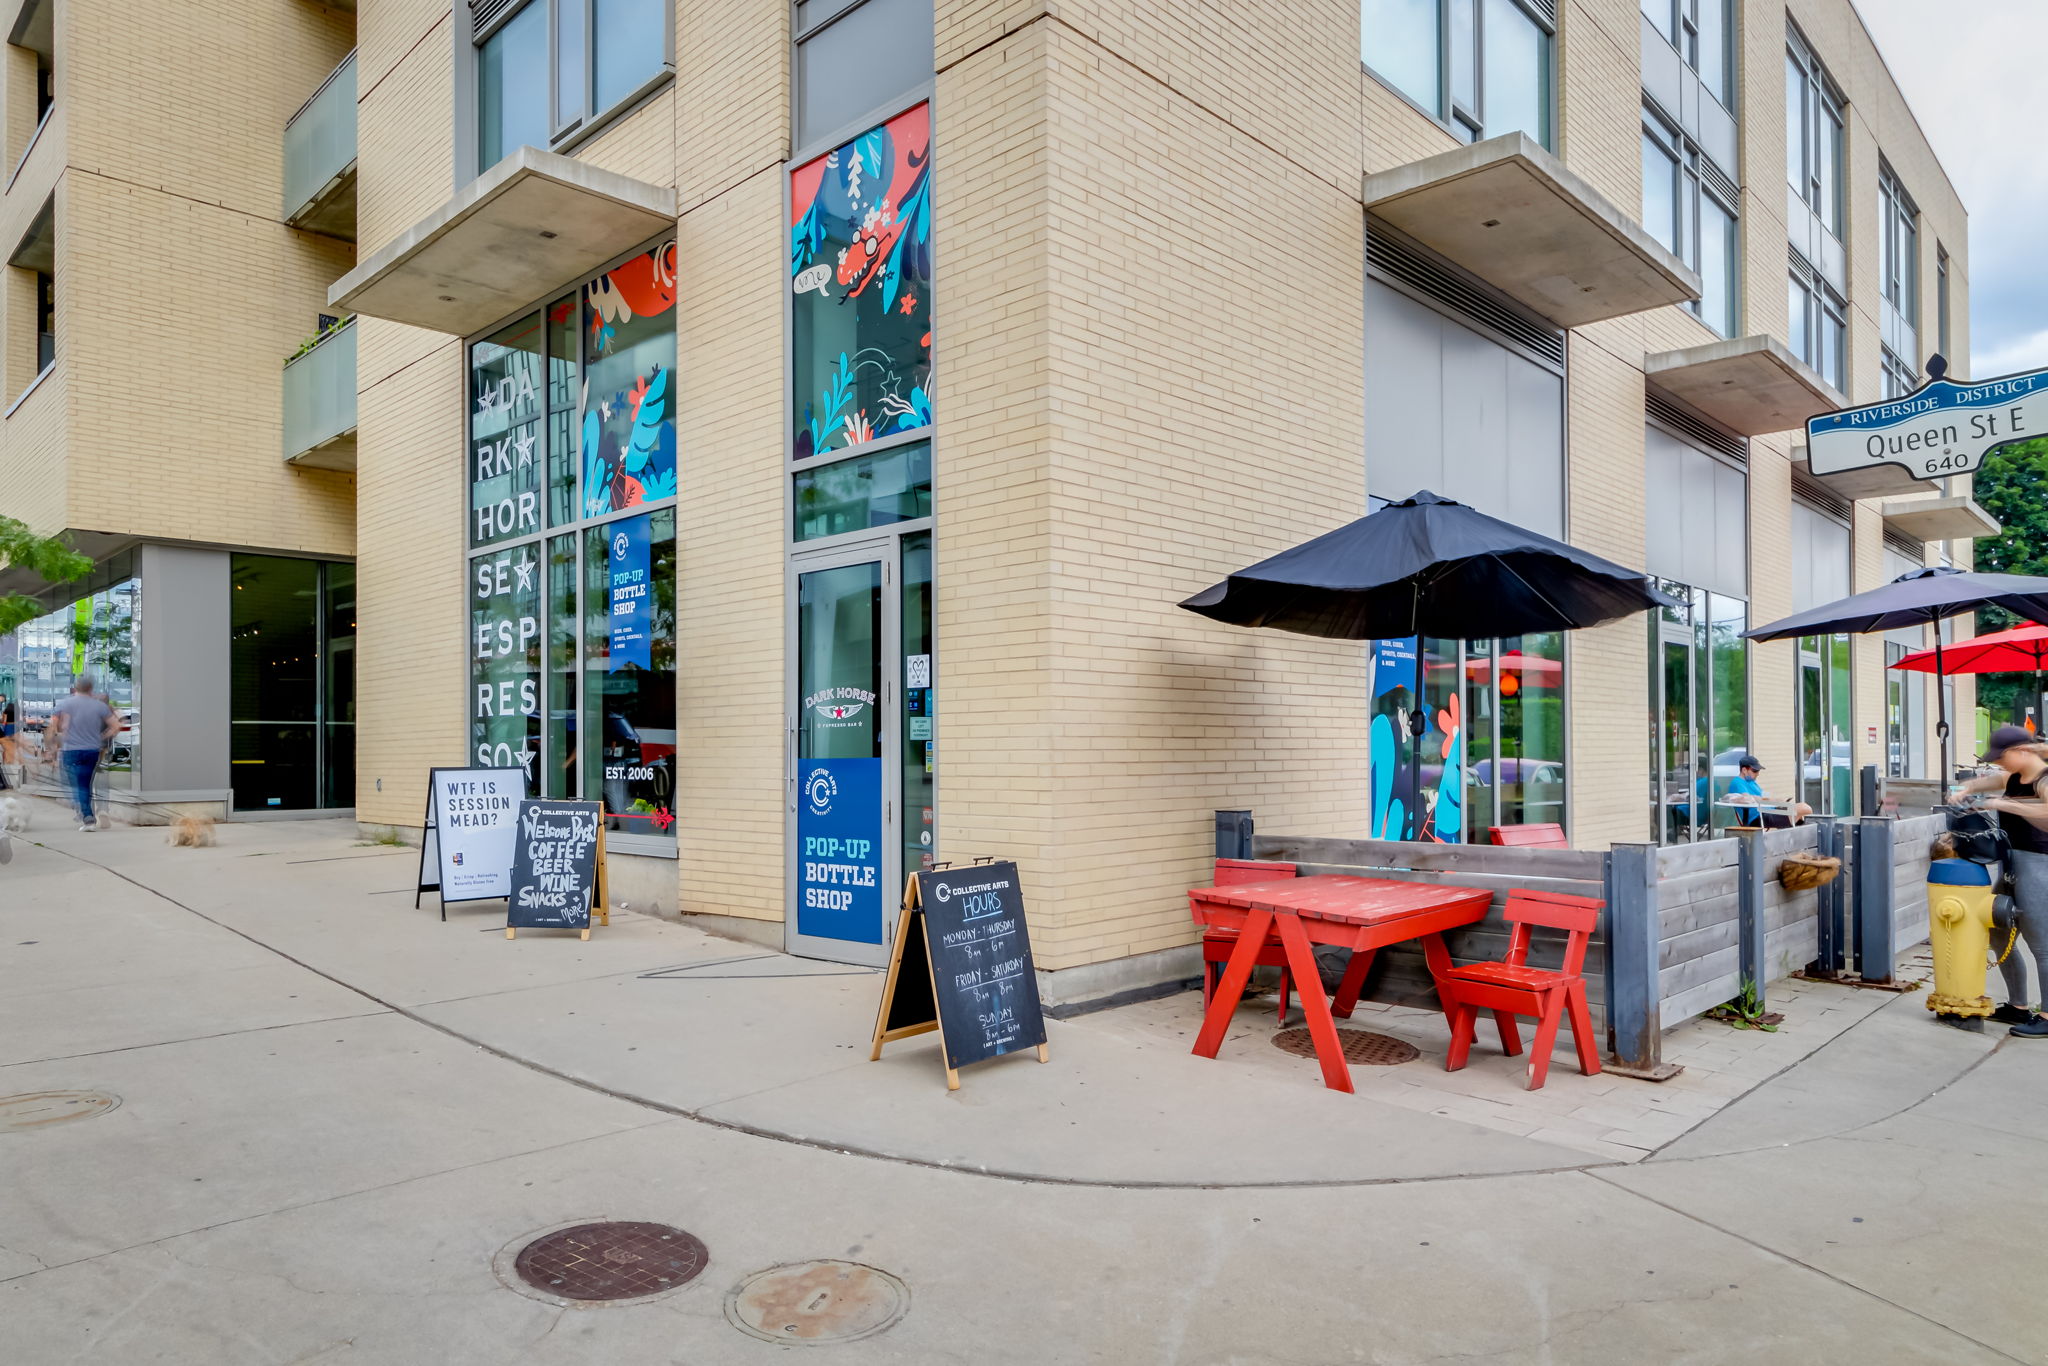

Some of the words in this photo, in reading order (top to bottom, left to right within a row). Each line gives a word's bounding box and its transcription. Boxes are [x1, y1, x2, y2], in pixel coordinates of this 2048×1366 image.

[498, 368, 535, 412] DA
[1850, 397, 1939, 425] RIVERSIDE
[1955, 377, 2036, 404] DISTRICT
[1866, 424, 1958, 459] Queen
[1970, 413, 1998, 439] St
[2010, 407, 2025, 432] E
[477, 436, 513, 482] RK
[1925, 454, 1969, 473] 640
[477, 491, 536, 541] HOR
[477, 557, 511, 599] SE
[614, 569, 643, 586] POP-UP
[614, 584, 646, 601] BOTTLE
[614, 601, 635, 616] SHOP
[477, 616, 536, 658] ESP
[477, 678, 536, 718] RES
[804, 688, 835, 709] DARK
[836, 687, 876, 706] HORSE
[605, 766, 626, 780] EST.
[628, 767, 654, 780] 2006
[805, 768, 830, 795] COLLECTIVE
[447, 782, 476, 795] WTF
[483, 781, 496, 794] IS
[449, 797, 510, 811] SESSION
[450, 813, 498, 827] MEAD?
[528, 840, 588, 860] COFFEE
[805, 836, 871, 859] POP-UP
[533, 858, 576, 876] BEER
[805, 862, 875, 887] BOTTLE
[540, 873, 581, 892] WINE
[952, 883, 992, 896] COLLECTIVE
[992, 880, 1010, 890] ARTS
[517, 885, 567, 909] SNACKS
[805, 887, 853, 911] SHOP
[962, 891, 1002, 918] HOURS
[943, 928, 976, 945] MONDAY
[982, 918, 1015, 934] THURSDAY
[955, 968, 982, 987] FRIDAY
[991, 957, 1023, 979] SATURDAY
[978, 1006, 1013, 1027] SUNDAY
